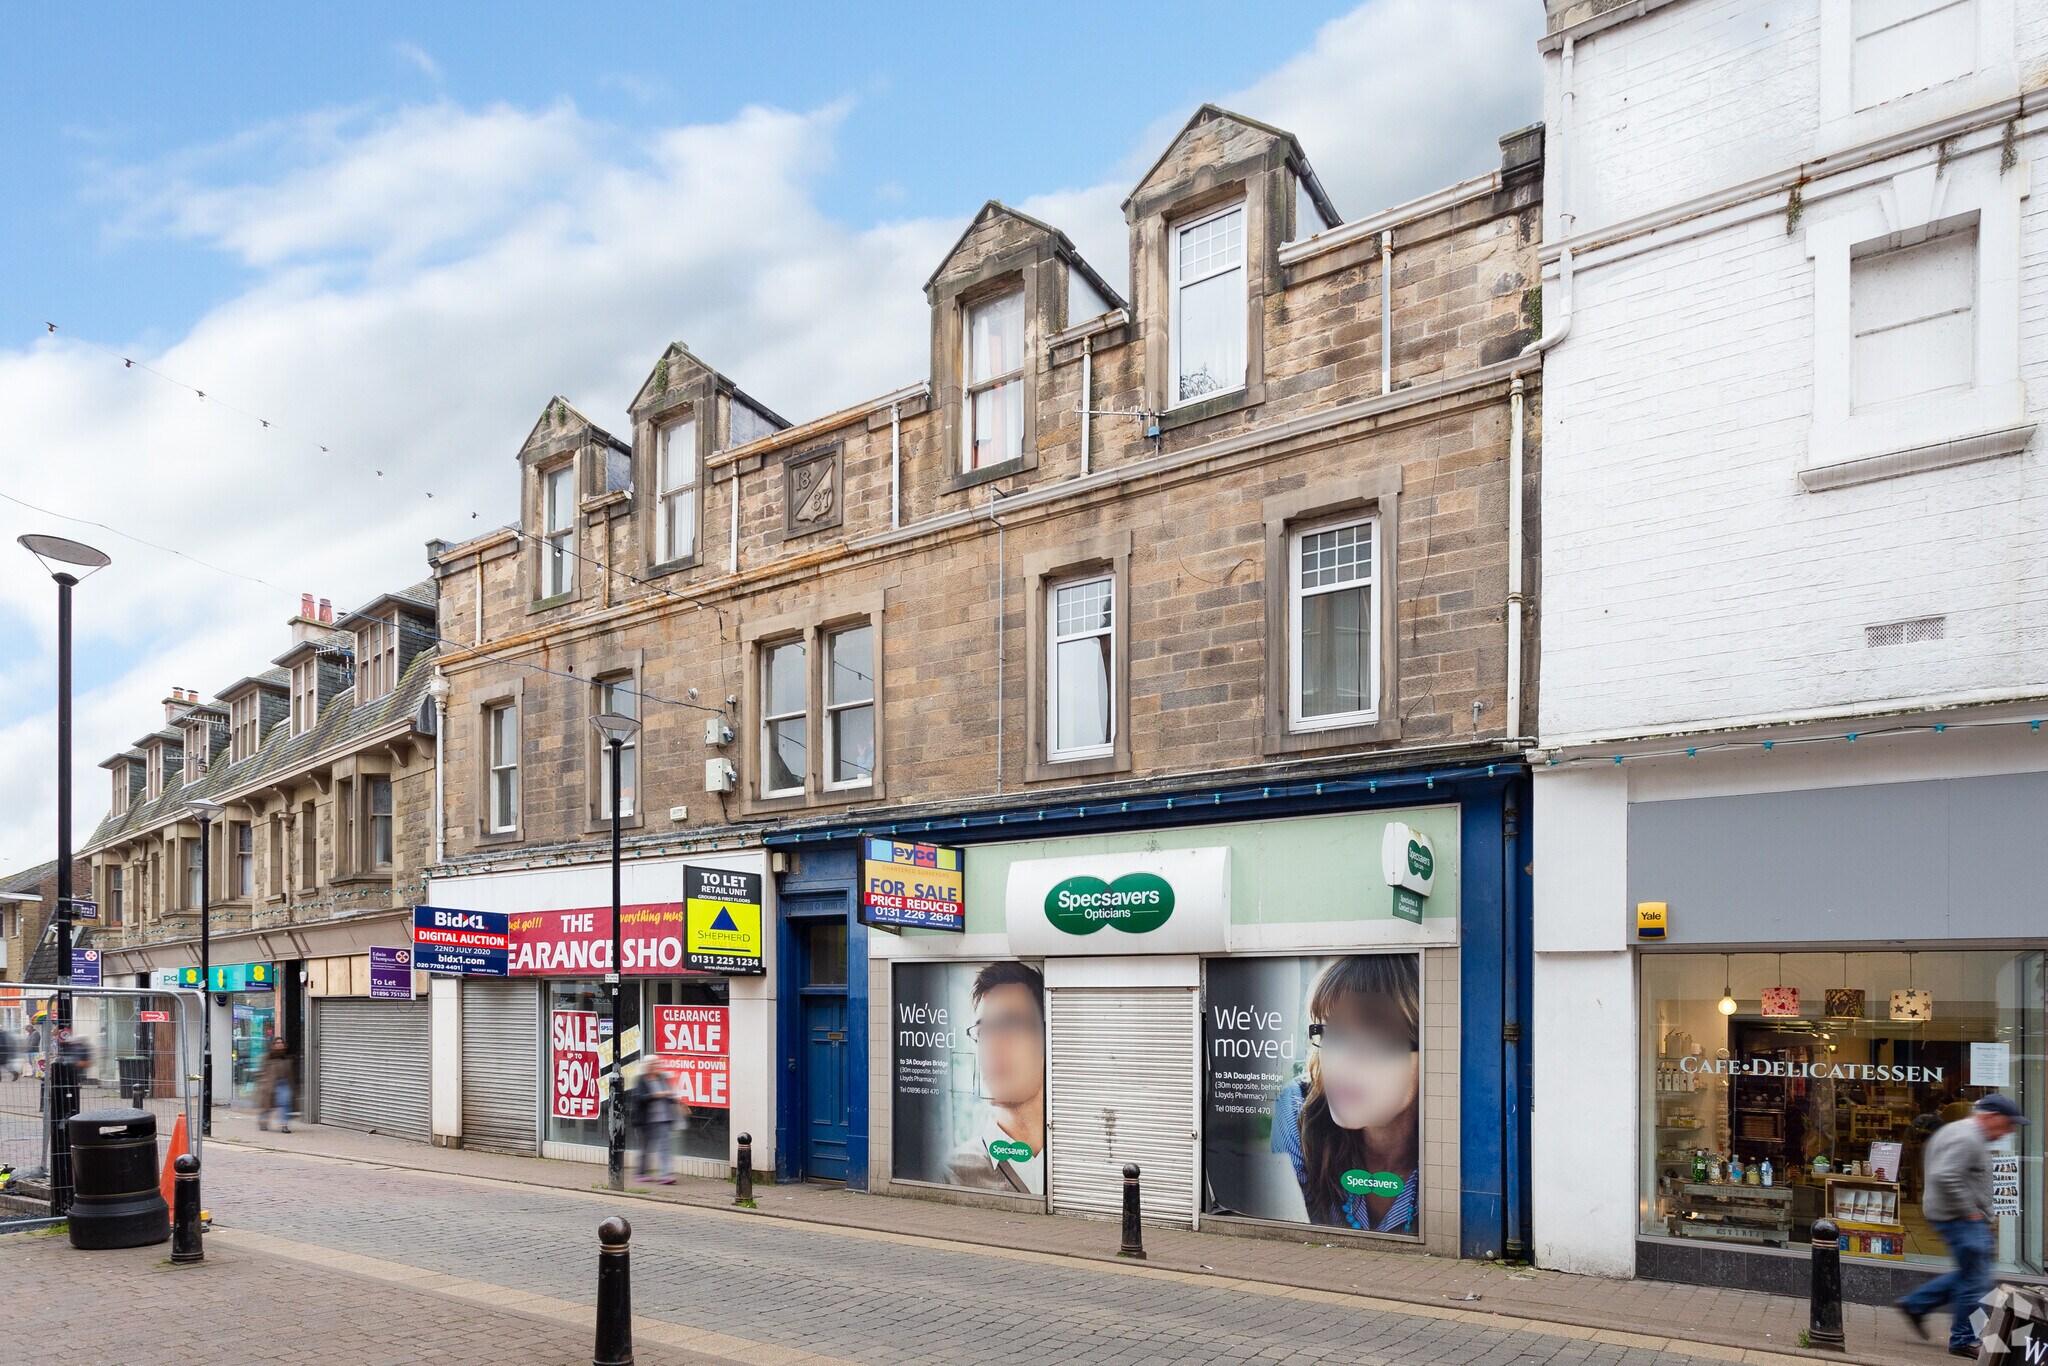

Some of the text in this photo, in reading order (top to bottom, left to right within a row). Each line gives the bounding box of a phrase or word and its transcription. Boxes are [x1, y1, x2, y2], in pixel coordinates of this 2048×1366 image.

[811, 487, 832, 511] 87
[893, 847, 936, 862] eyco
[1409, 847, 1430, 867] Specsavers
[882, 865, 949, 878] CHARTERED SURVEYORS
[701, 873, 746, 888] TO LET
[701, 886, 747, 896] RETAIL UNIT
[870, 878, 957, 902] FOR SALE
[870, 895, 957, 913] PRICE REDUCED
[1058, 890, 1159, 911] Specsavers
[620, 910, 683, 925] verything mus
[875, 906, 954, 922] 0131 226 2641
[1084, 907, 1131, 921] Opticians
[1641, 912, 1662, 920] Yale
[508, 917, 543, 932] ust go!!!
[561, 914, 594, 933] THE
[419, 930, 504, 946] DIGITAL AUCTION
[698, 930, 750, 942] SHEPHERD
[434, 945, 454, 953] 22ND
[508, 937, 682, 969] EARANCE SHO
[438, 954, 485, 965] bidx1.com
[691, 955, 714, 963] 0131
[737, 958, 759, 966] 1234
[663, 1009, 721, 1022] CLEARANCE
[900, 1003, 948, 1024] We've
[1214, 1005, 1282, 1030] We've
[554, 1014, 598, 1052] SALE
[664, 1024, 721, 1052] SALE
[900, 1027, 956, 1048] moved
[1215, 1033, 1294, 1058] moved
[664, 1060, 726, 1070] LOSING DOWN
[913, 1059, 932, 1067] Douglas
[557, 1060, 596, 1097] 50%
[914, 1076, 937, 1084] Pharmacy)
[1233, 1072, 1260, 1082] Douglas
[1261, 1073, 1284, 1082] Bridge
[676, 1071, 727, 1104] ALE
[1215, 1082, 1231, 1090] (30m
[1232, 1083, 1260, 1091] opposite,
[1215, 1091, 1267, 1101] Lloyds Pharmacy)
[558, 1096, 594, 1116] OFF
[1225, 1105, 1244, 1113] 01896
[1258, 1106, 1270, 1114] 470
[992, 1145, 1029, 1156] Specsavers
[1347, 1175, 1398, 1190] Specsavers
